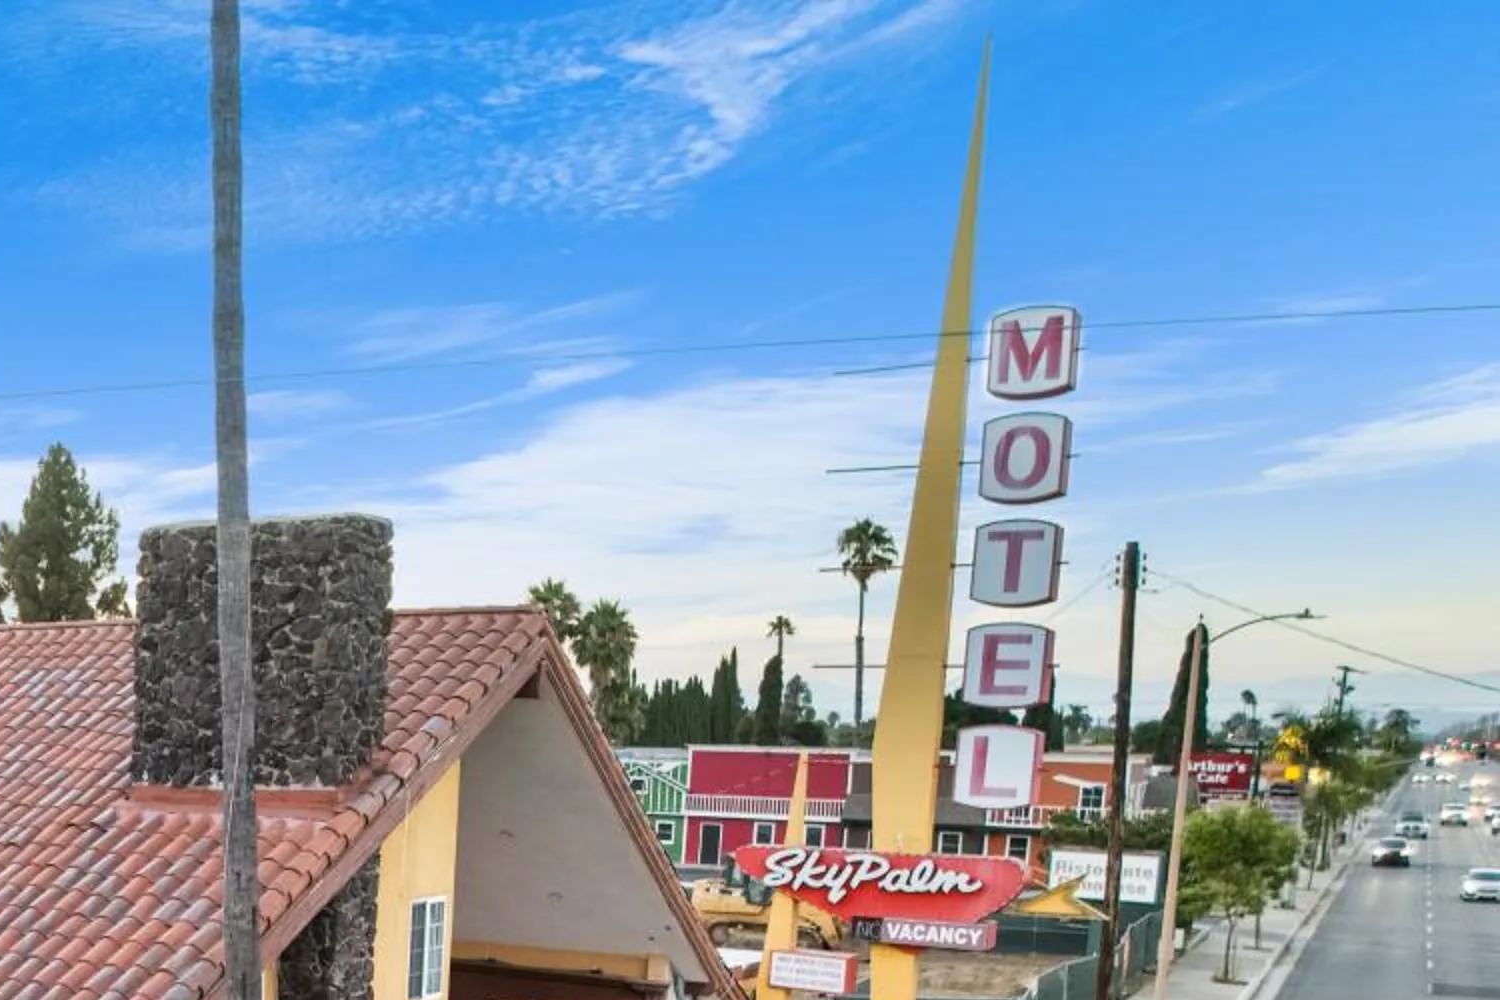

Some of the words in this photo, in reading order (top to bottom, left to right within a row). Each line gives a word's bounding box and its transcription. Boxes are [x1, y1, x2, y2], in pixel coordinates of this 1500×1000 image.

[969, 314, 1065, 799] MOTEL
[1197, 773, 1229, 785] Cafe
[886, 922, 983, 945] VACANCY
